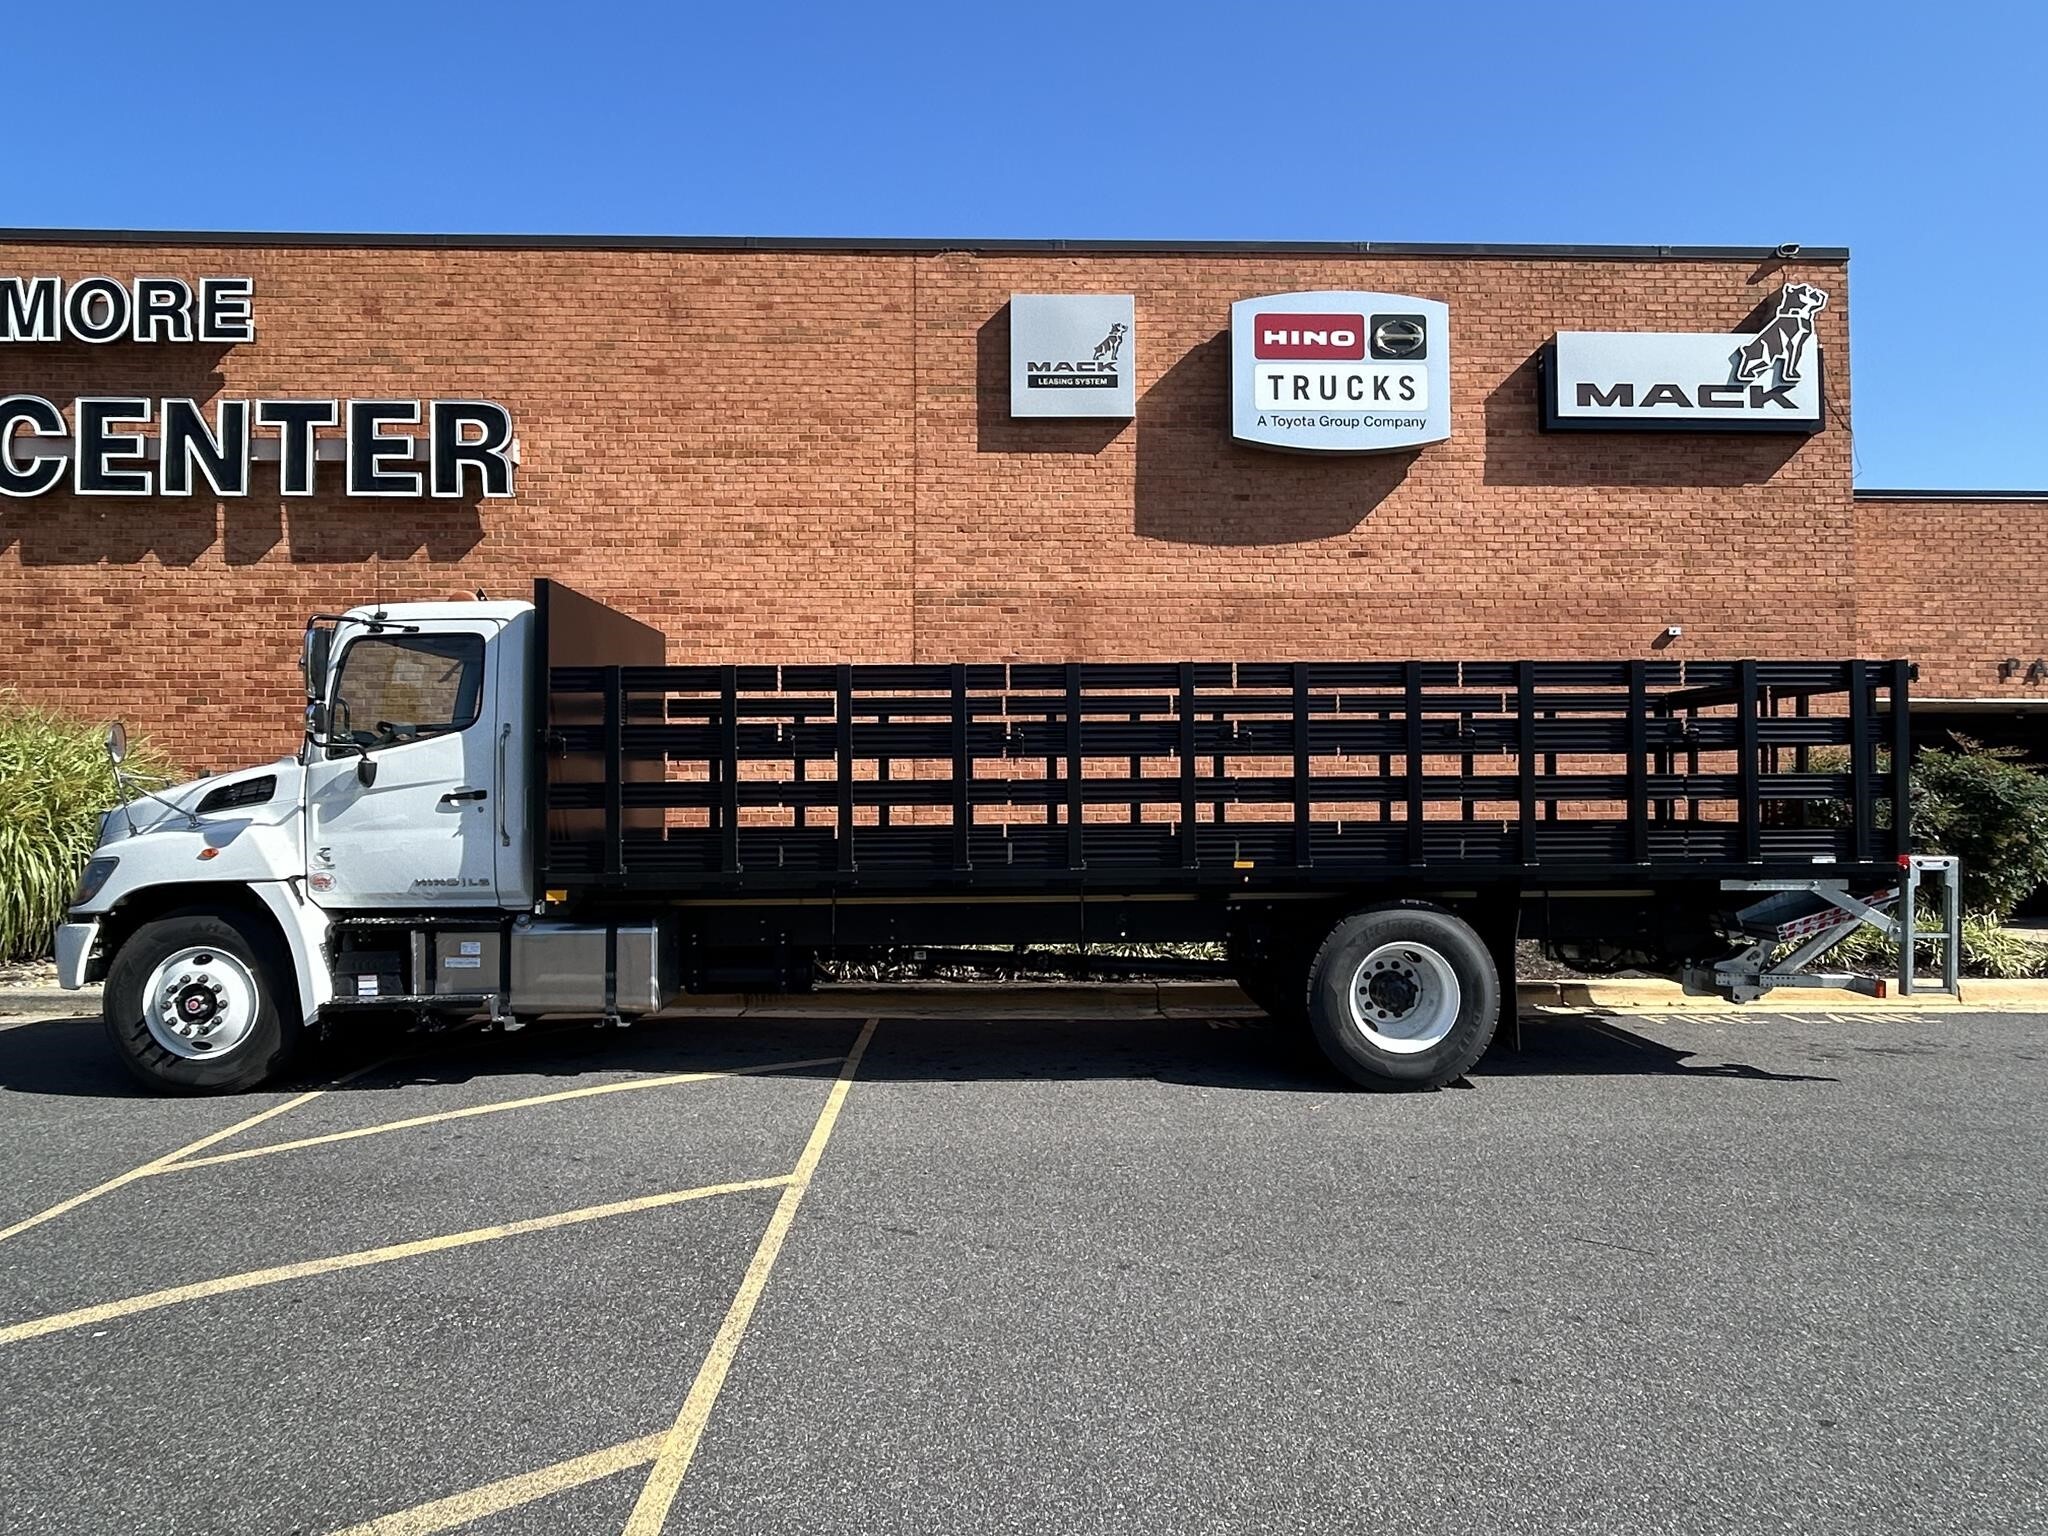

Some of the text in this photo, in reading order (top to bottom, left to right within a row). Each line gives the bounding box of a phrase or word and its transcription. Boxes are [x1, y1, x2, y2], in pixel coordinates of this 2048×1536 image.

[0, 276, 255, 343] MORE
[1263, 330, 1356, 347] HINO
[1027, 361, 1118, 372] MACK
[1038, 378, 1108, 386] LEASING SYSTEM
[1267, 374, 1416, 402] TRUCKS
[1576, 382, 1800, 410] MACK
[1257, 415, 1427, 430] A Toyota Group Company
[0, 394, 515, 499] CENTER
